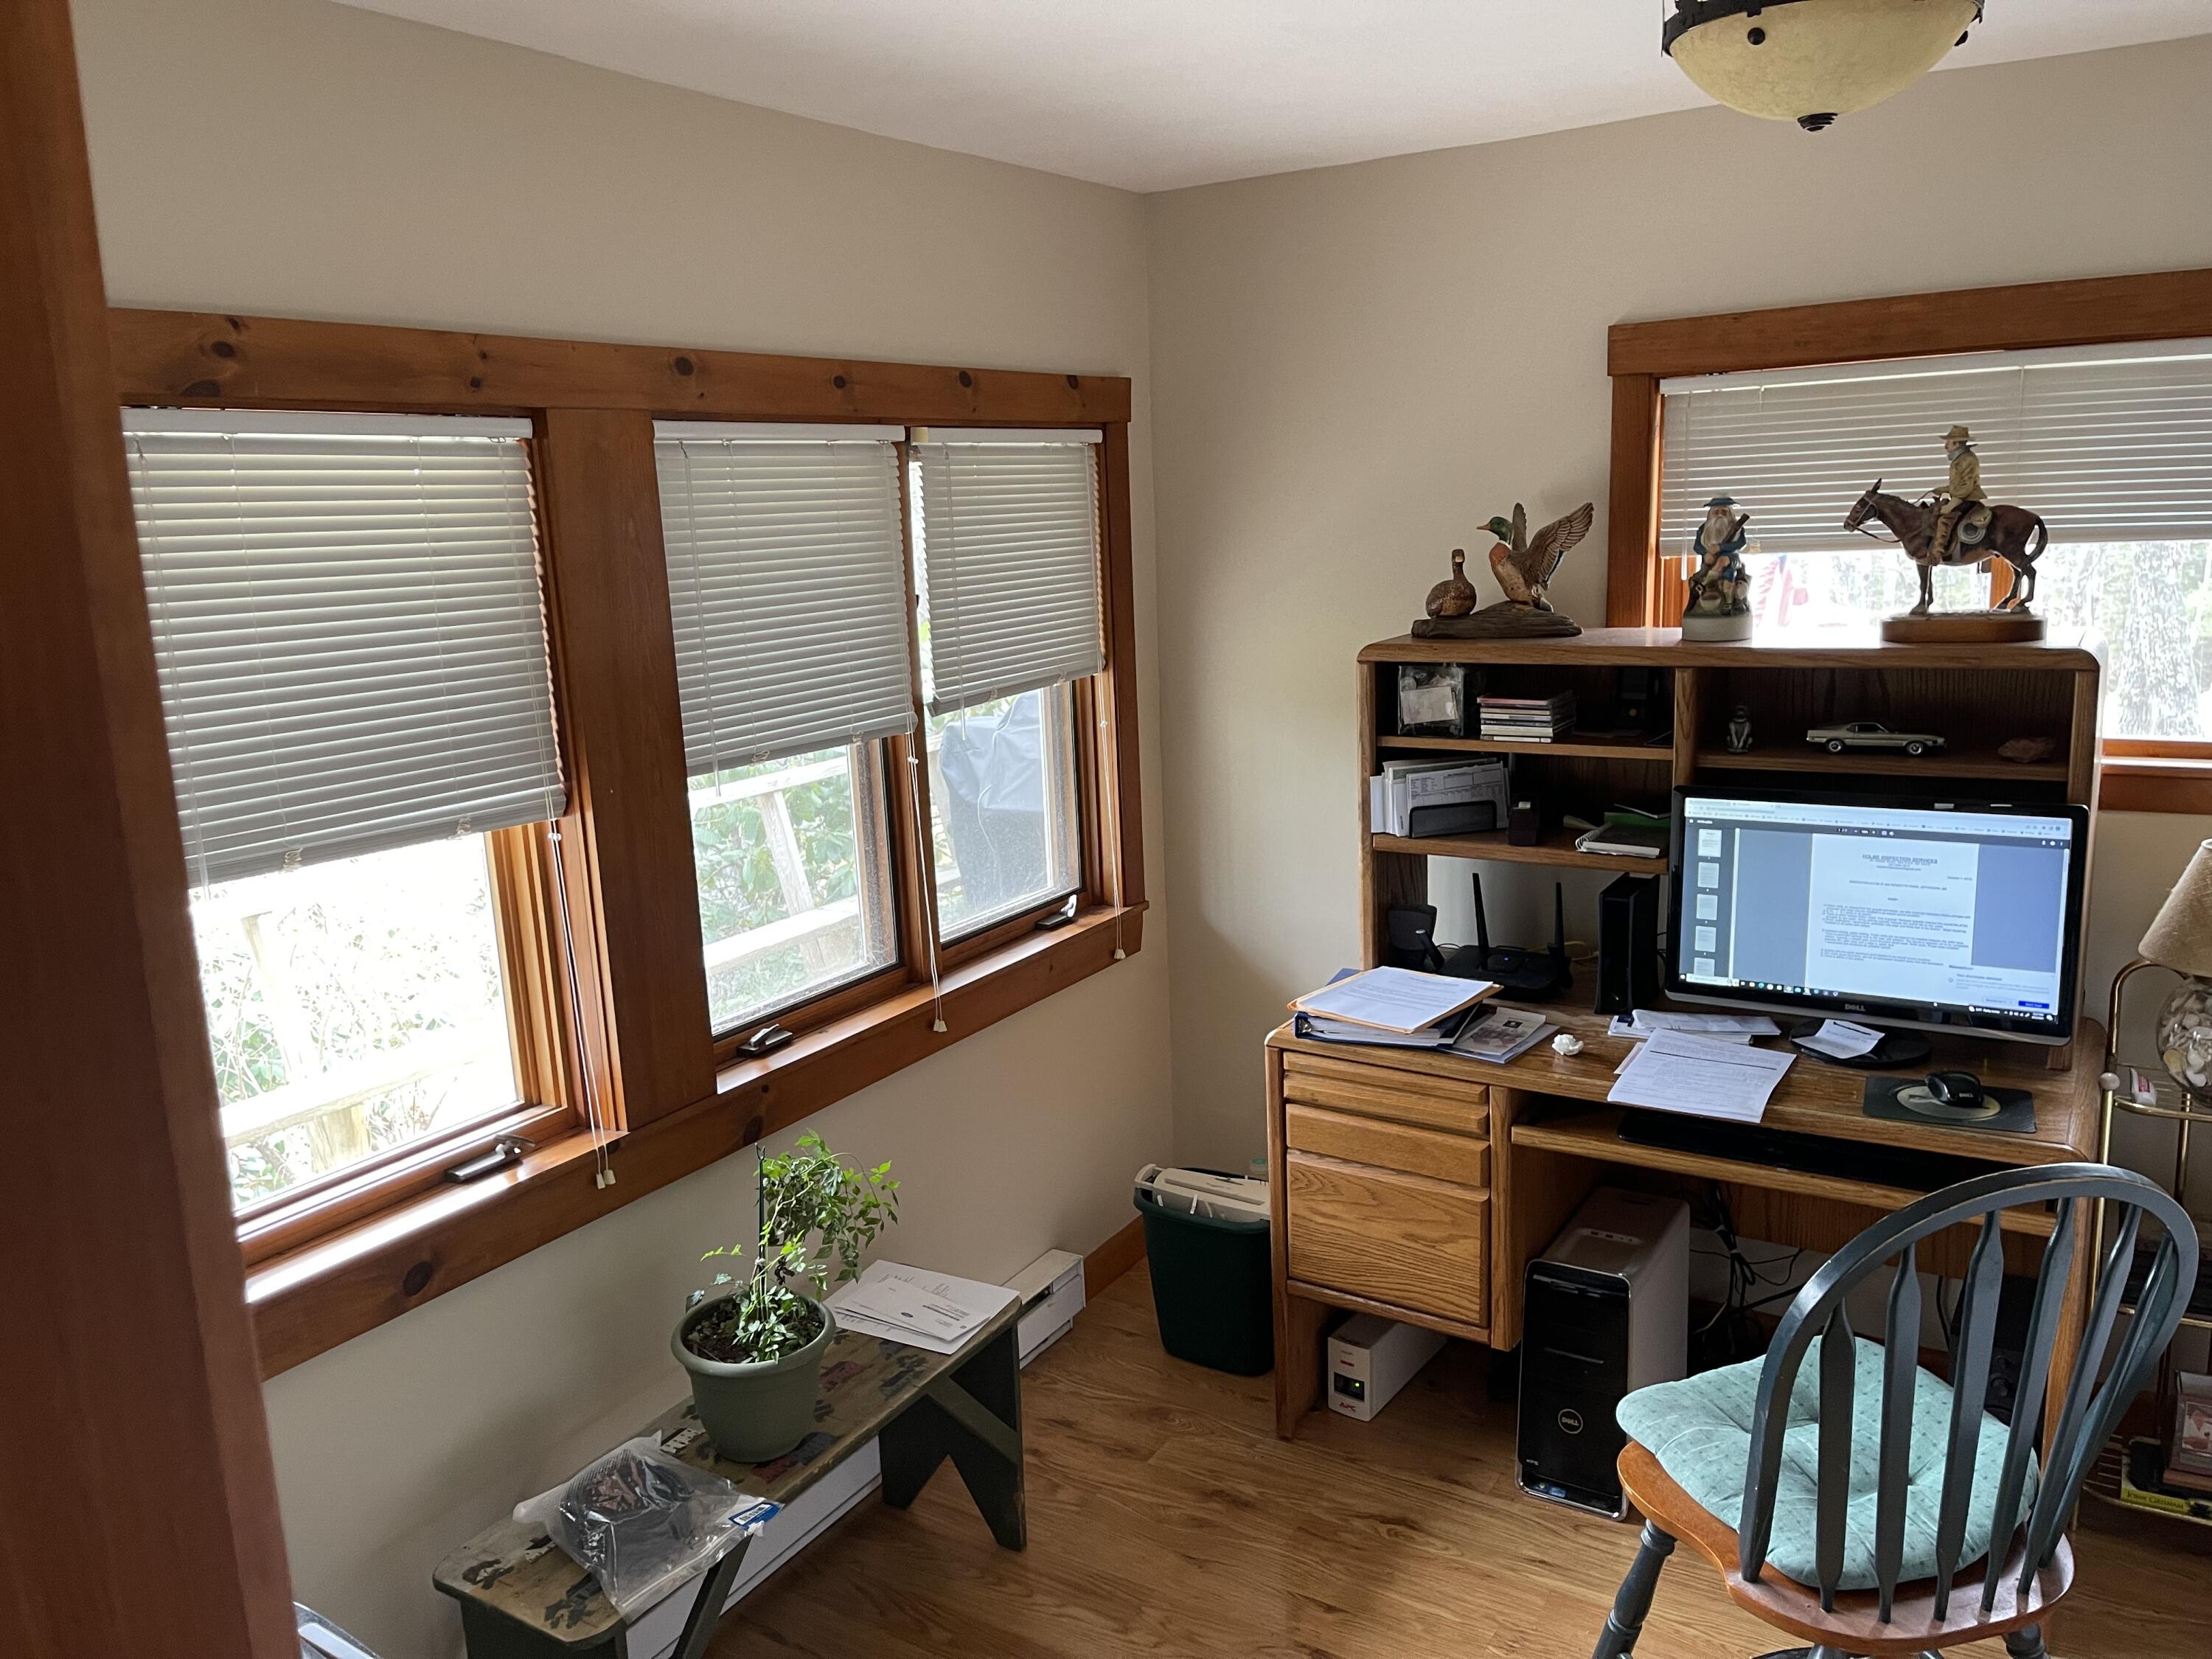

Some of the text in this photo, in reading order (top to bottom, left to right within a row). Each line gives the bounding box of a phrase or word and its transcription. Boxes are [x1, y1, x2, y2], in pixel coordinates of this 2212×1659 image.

[1844, 1004, 1866, 1012] DELL
[1339, 1402, 1357, 1412] APC
[1561, 1416, 1579, 1426] DELL
